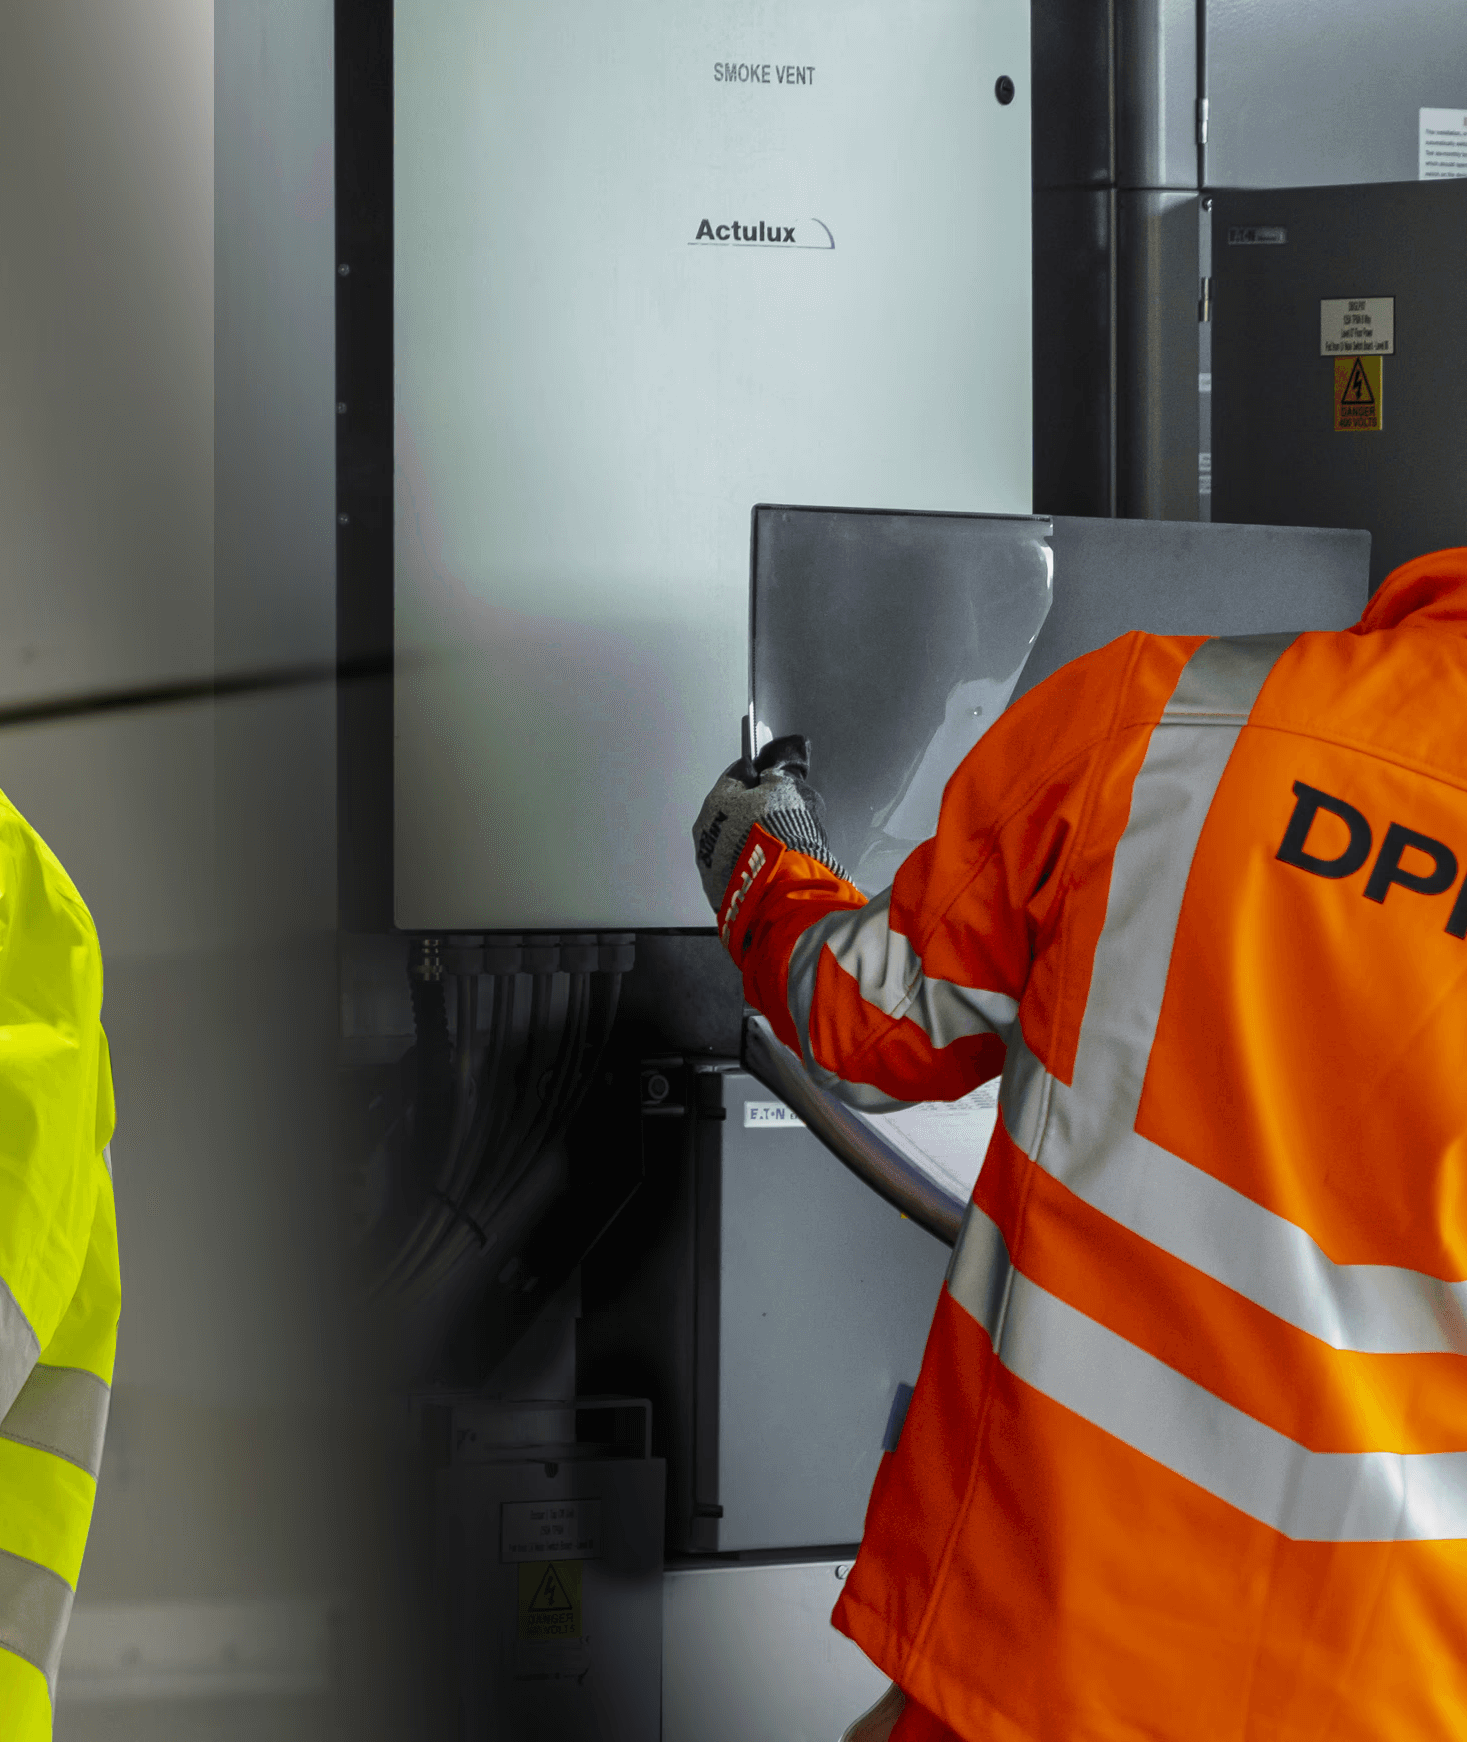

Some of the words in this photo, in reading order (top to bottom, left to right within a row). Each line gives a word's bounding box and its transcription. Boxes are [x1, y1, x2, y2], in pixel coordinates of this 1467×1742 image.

[714, 62, 771, 83] SMOKE
[775, 65, 816, 85] VENT
[695, 218, 796, 243] Actulux
